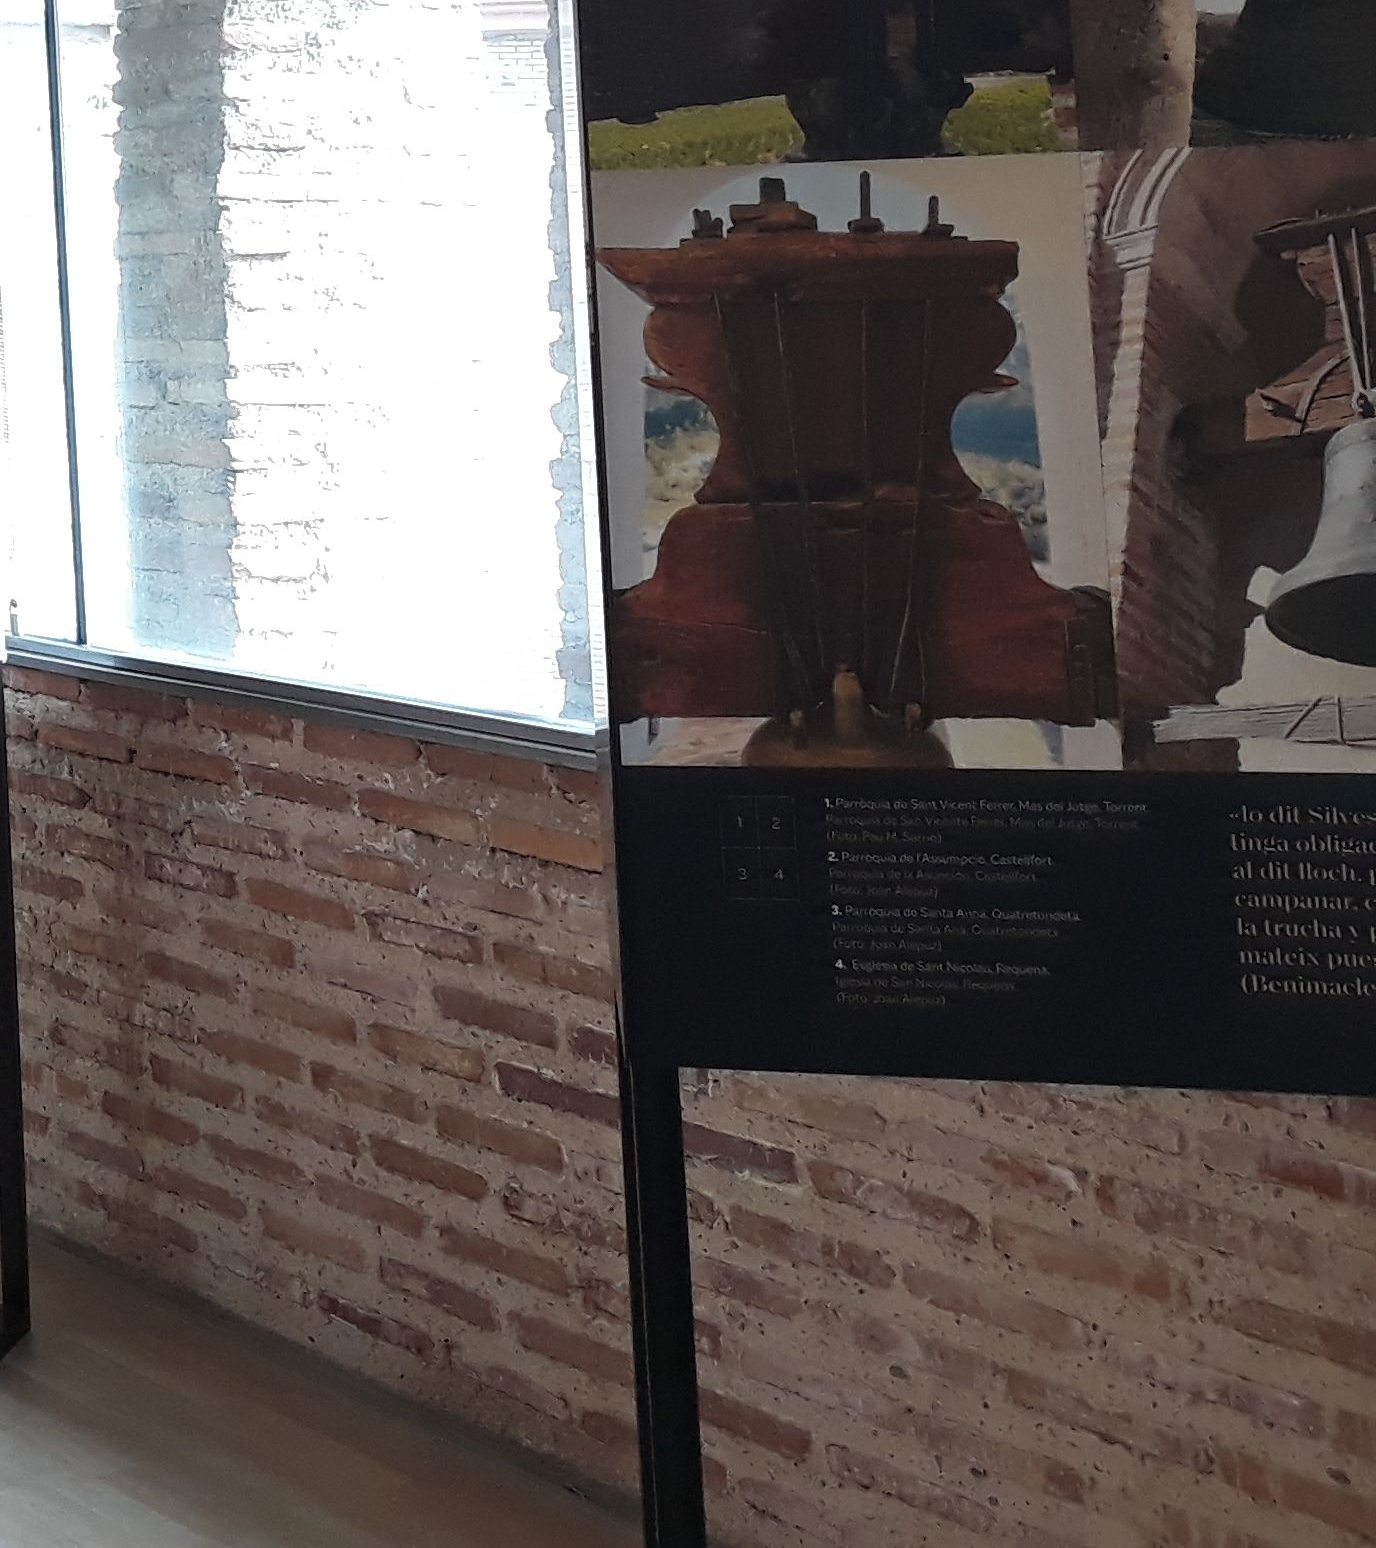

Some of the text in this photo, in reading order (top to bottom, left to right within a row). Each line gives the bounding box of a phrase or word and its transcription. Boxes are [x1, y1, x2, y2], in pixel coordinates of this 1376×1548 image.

[911, 798, 937, 811] Sant
[938, 798, 977, 811] Vicent
[1017, 799, 1044, 812] Mas
[1269, 804, 1299, 825] dit
[737, 815, 782, 830] 1 2
[1230, 832, 1289, 855] tinga
[899, 852, 914, 864] de
[738, 867, 784, 881] 3 4
[1232, 861, 1252, 880] al
[1260, 861, 1290, 880] dit
[831, 904, 843, 916] 3.
[919, 906, 955, 919] Santa
[1236, 916, 1359, 944] la trucha y
[1239, 947, 1320, 966] mateix
[834, 958, 848, 971] 4.
